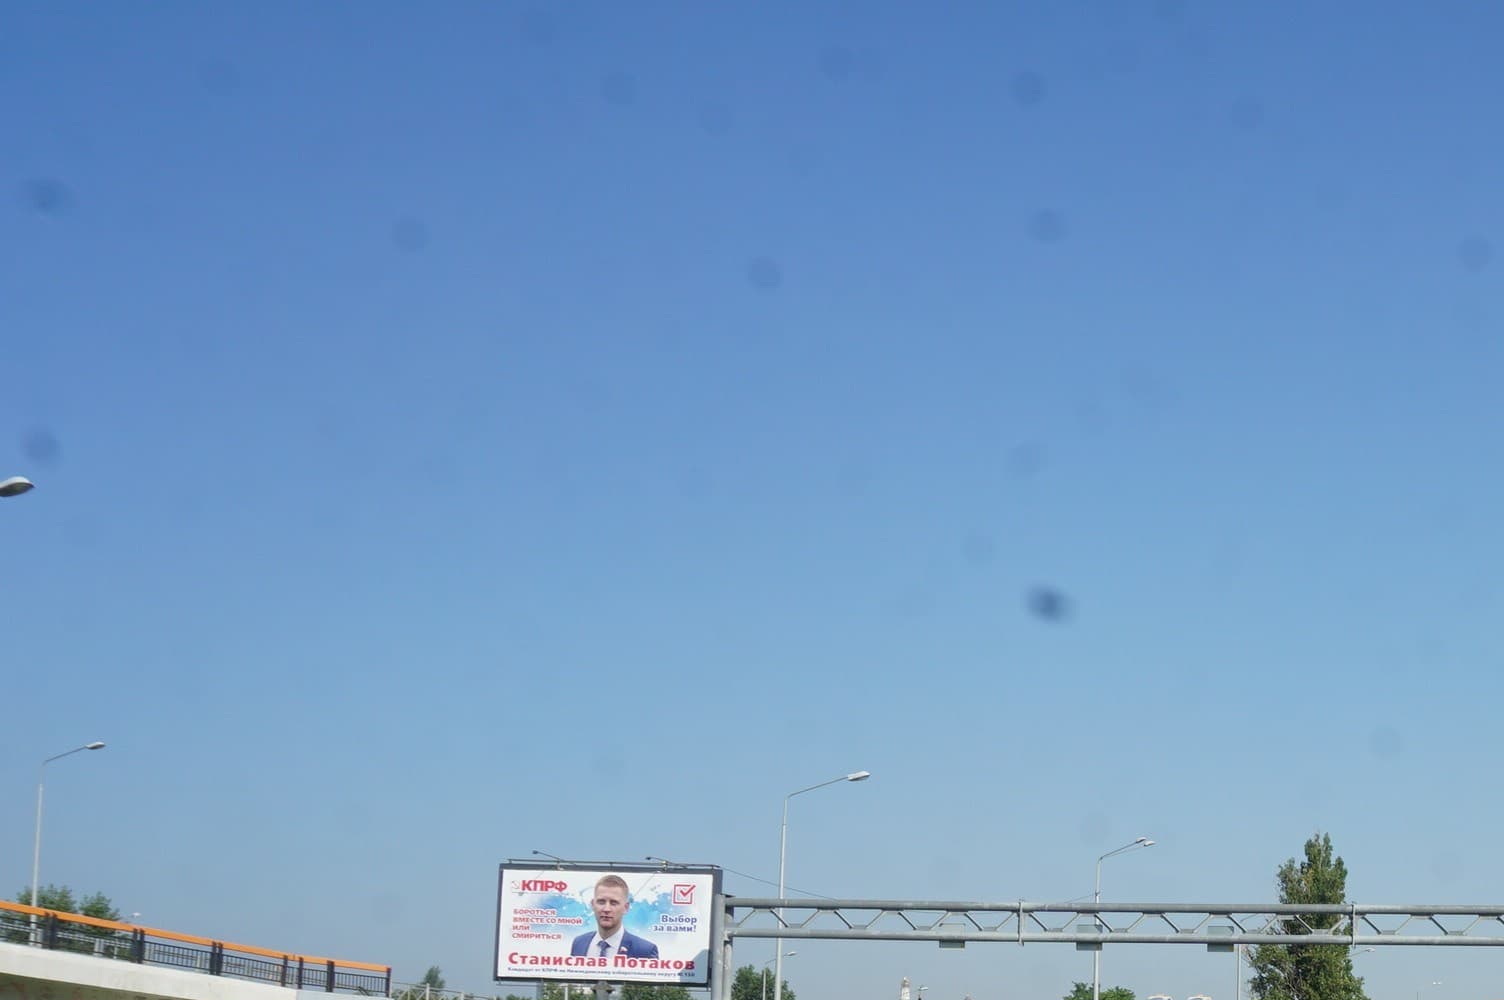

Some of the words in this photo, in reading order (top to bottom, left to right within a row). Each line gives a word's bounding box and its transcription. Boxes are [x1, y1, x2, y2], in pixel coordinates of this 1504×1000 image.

[521, 880, 568, 892] КПРФ
[661, 914, 697, 925] Выбор
[507, 952, 607, 967] Станислав
[614, 955, 695, 970] Потаков
